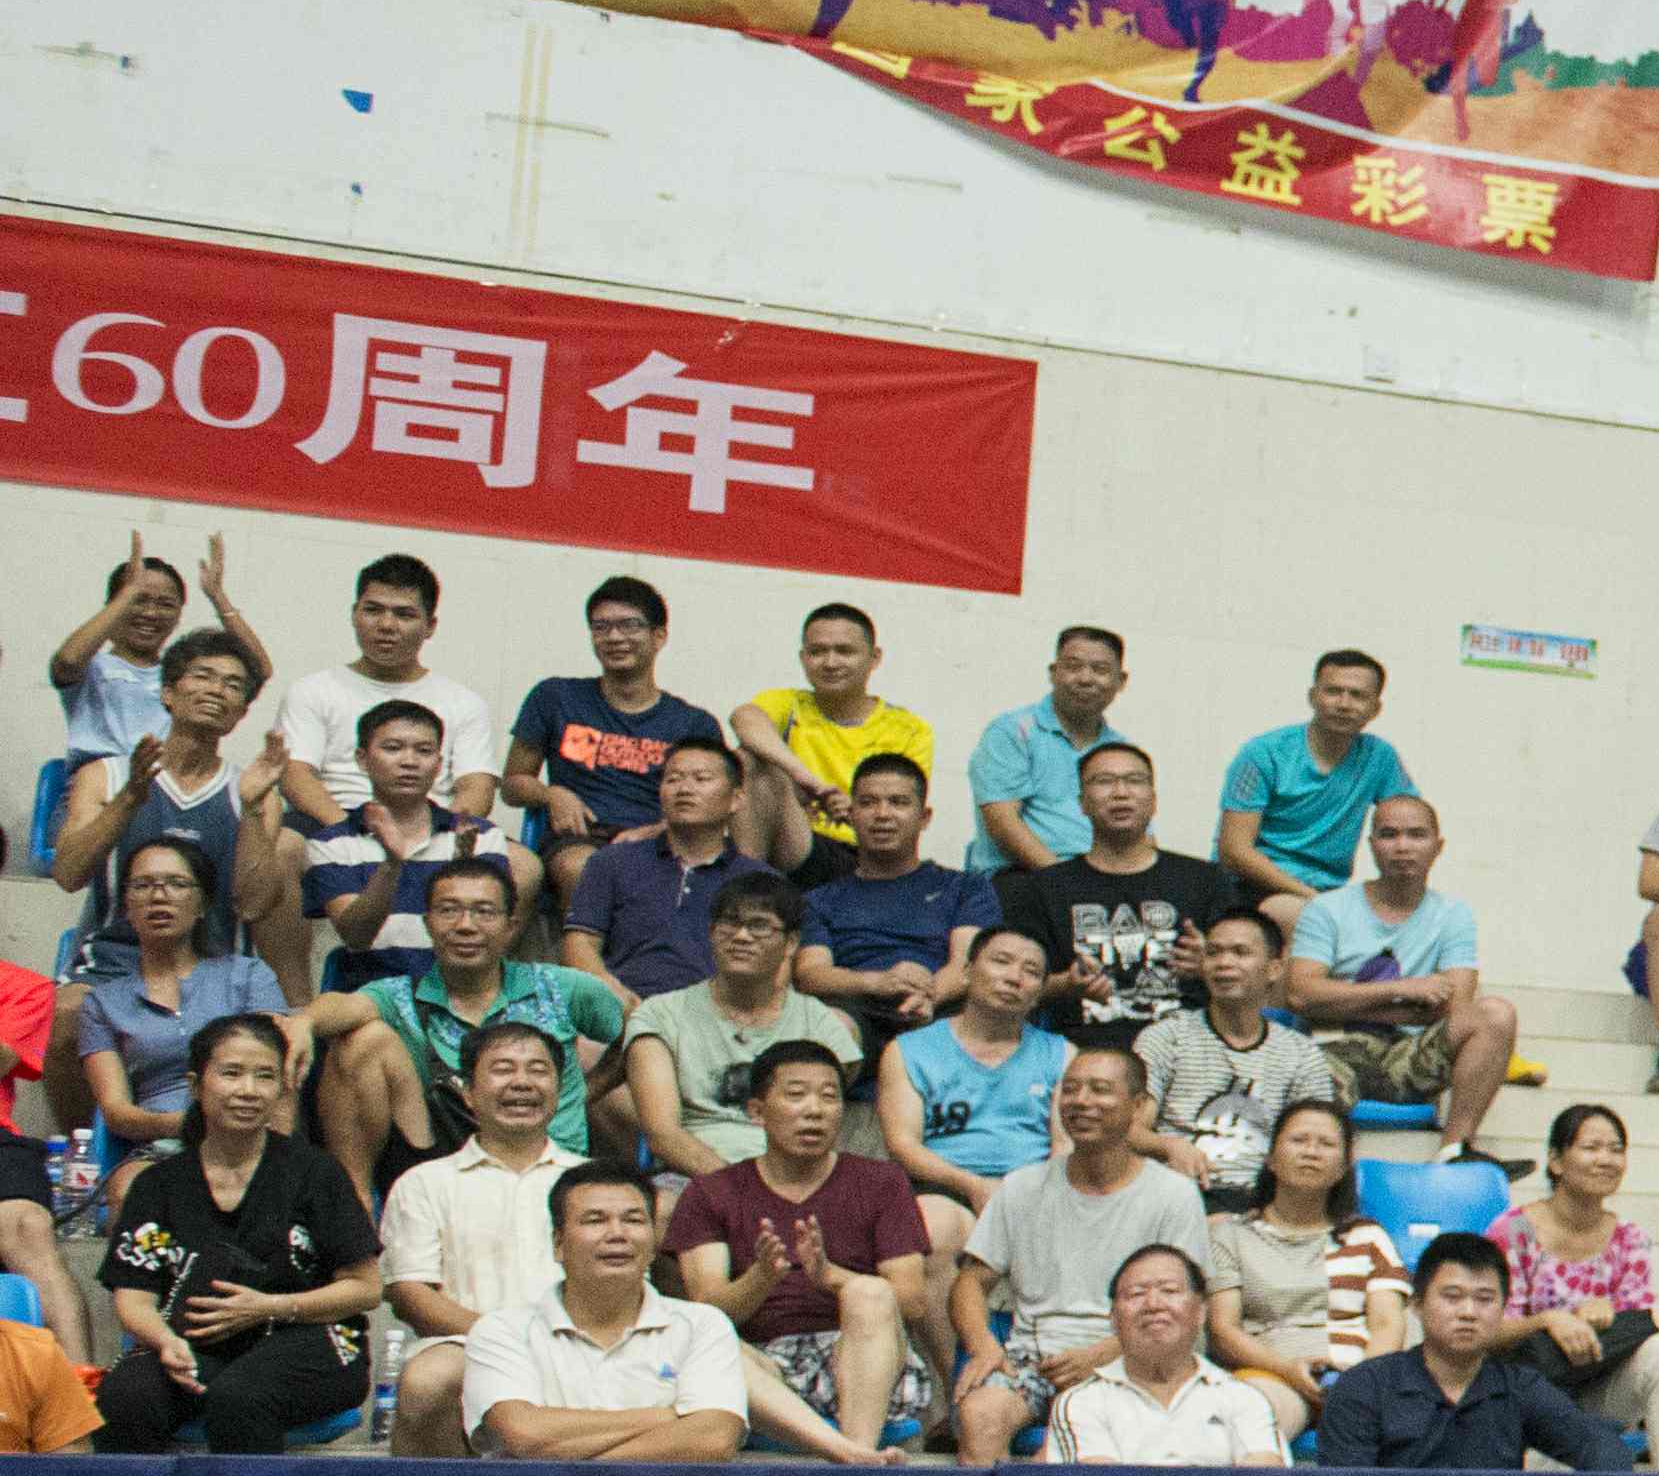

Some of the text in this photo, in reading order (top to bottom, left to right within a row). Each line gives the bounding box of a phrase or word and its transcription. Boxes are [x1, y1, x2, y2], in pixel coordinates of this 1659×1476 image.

[832, 41, 1559, 254] 家公益彩票
[0, 291, 815, 514] 60周年
